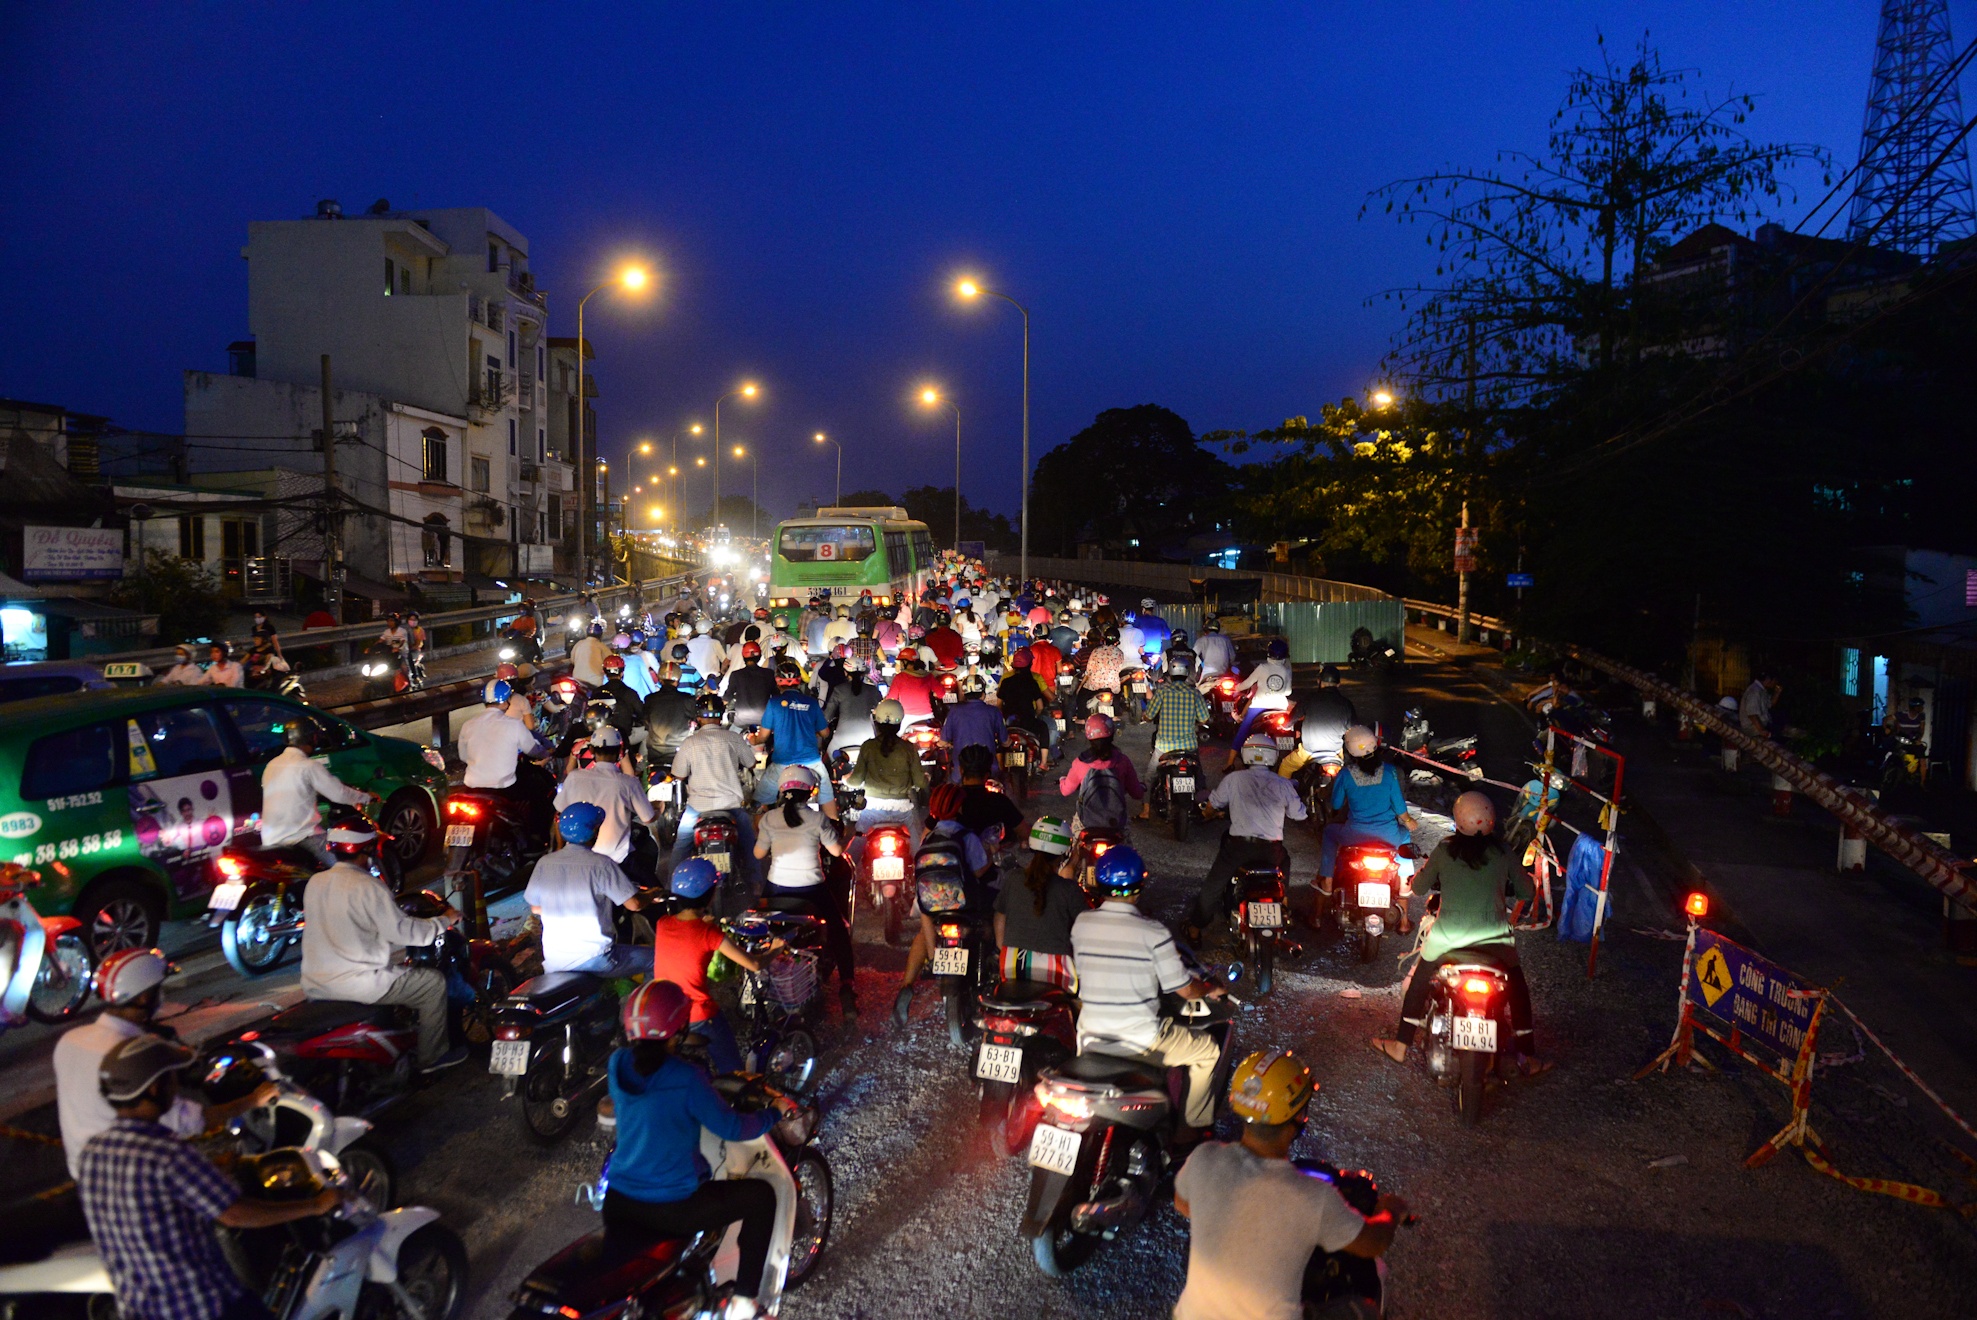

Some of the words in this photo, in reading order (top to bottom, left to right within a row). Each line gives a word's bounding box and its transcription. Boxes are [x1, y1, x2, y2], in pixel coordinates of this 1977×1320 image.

[820, 544, 832, 557] 8
[1, 818, 35, 834] 8983
[35, 843, 56, 865] 38
[59, 838, 79, 860] 38
[81, 834, 101, 855] 38
[103, 829, 122, 850] 38
[1253, 904, 1276, 915] 51-L1
[1253, 915, 1277, 926] 7251
[939, 950, 963, 961] 59-K1
[934, 962, 966, 973] 551.56
[1740, 962, 1765, 995] CÔNG
[495, 1042, 524, 1055] 50-H3
[1457, 1034, 1494, 1049] 104.94
[987, 1047, 1015, 1064] 63-B1
[980, 1062, 1017, 1080] 419.79
[1041, 1130, 1072, 1151] 59-H1
[1032, 1146, 1073, 1171] 377.62
